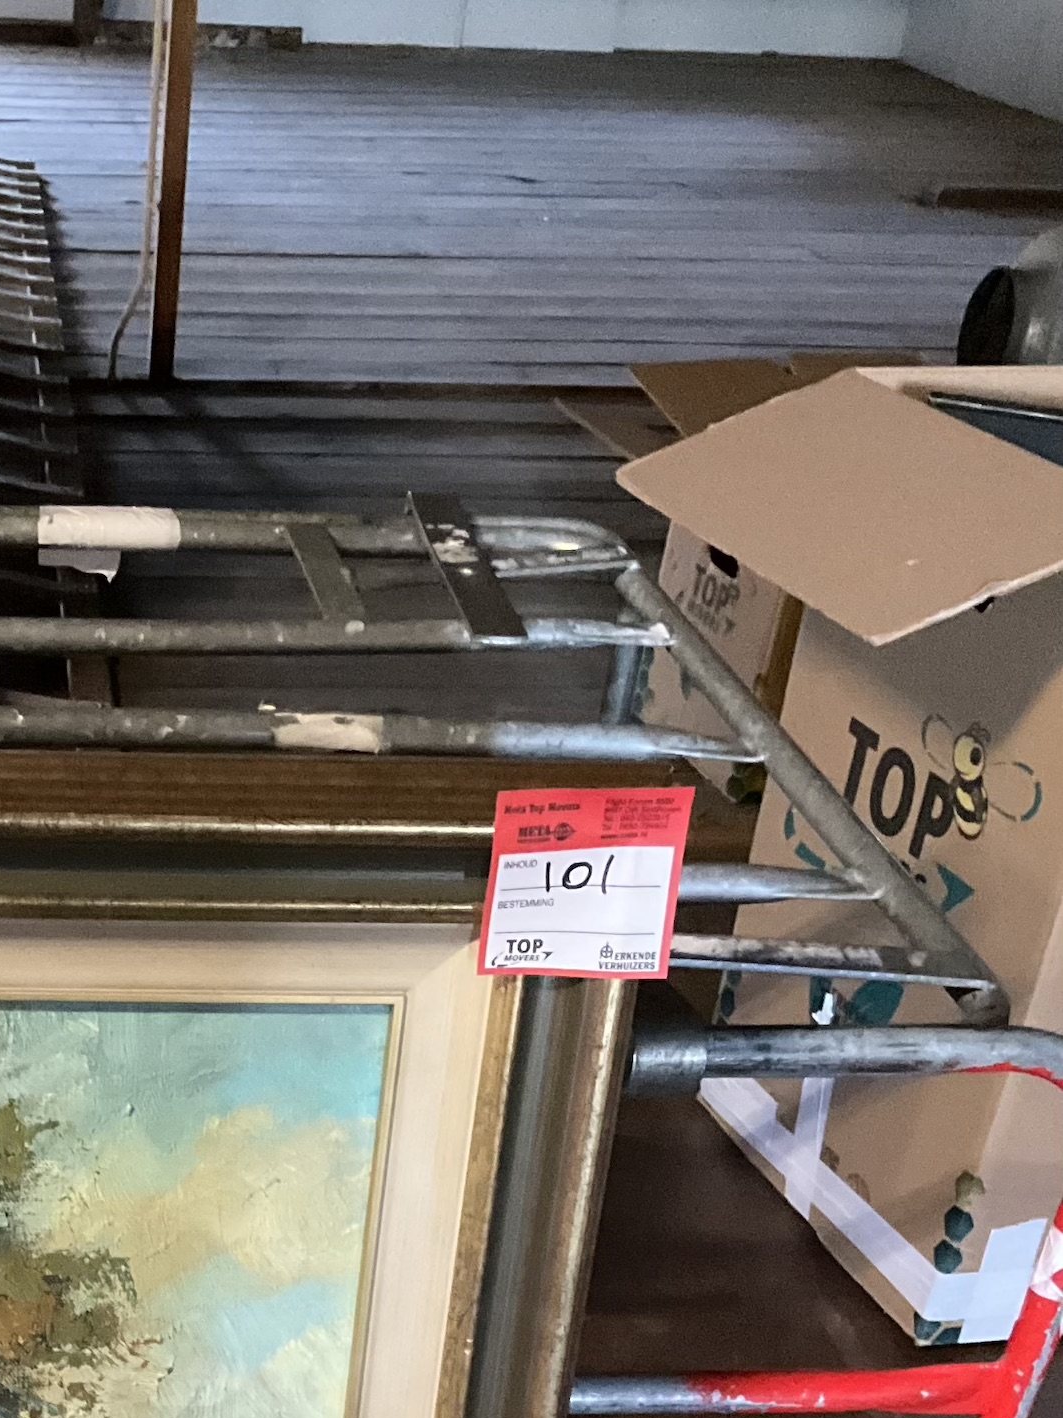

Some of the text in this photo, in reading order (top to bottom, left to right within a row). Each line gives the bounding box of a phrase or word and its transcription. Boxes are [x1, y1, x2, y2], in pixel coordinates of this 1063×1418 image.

[843, 715, 957, 860] TOP
[503, 859, 538, 870] INHOUD
[545, 854, 615, 895] 101
[497, 898, 555, 910] BESTEMMING
[506, 938, 544, 954] TOP
[503, 954, 541, 962] MOVERS
[614, 951, 657, 961] ERKENDE
[598, 961, 656, 971] VERHUIZERS
